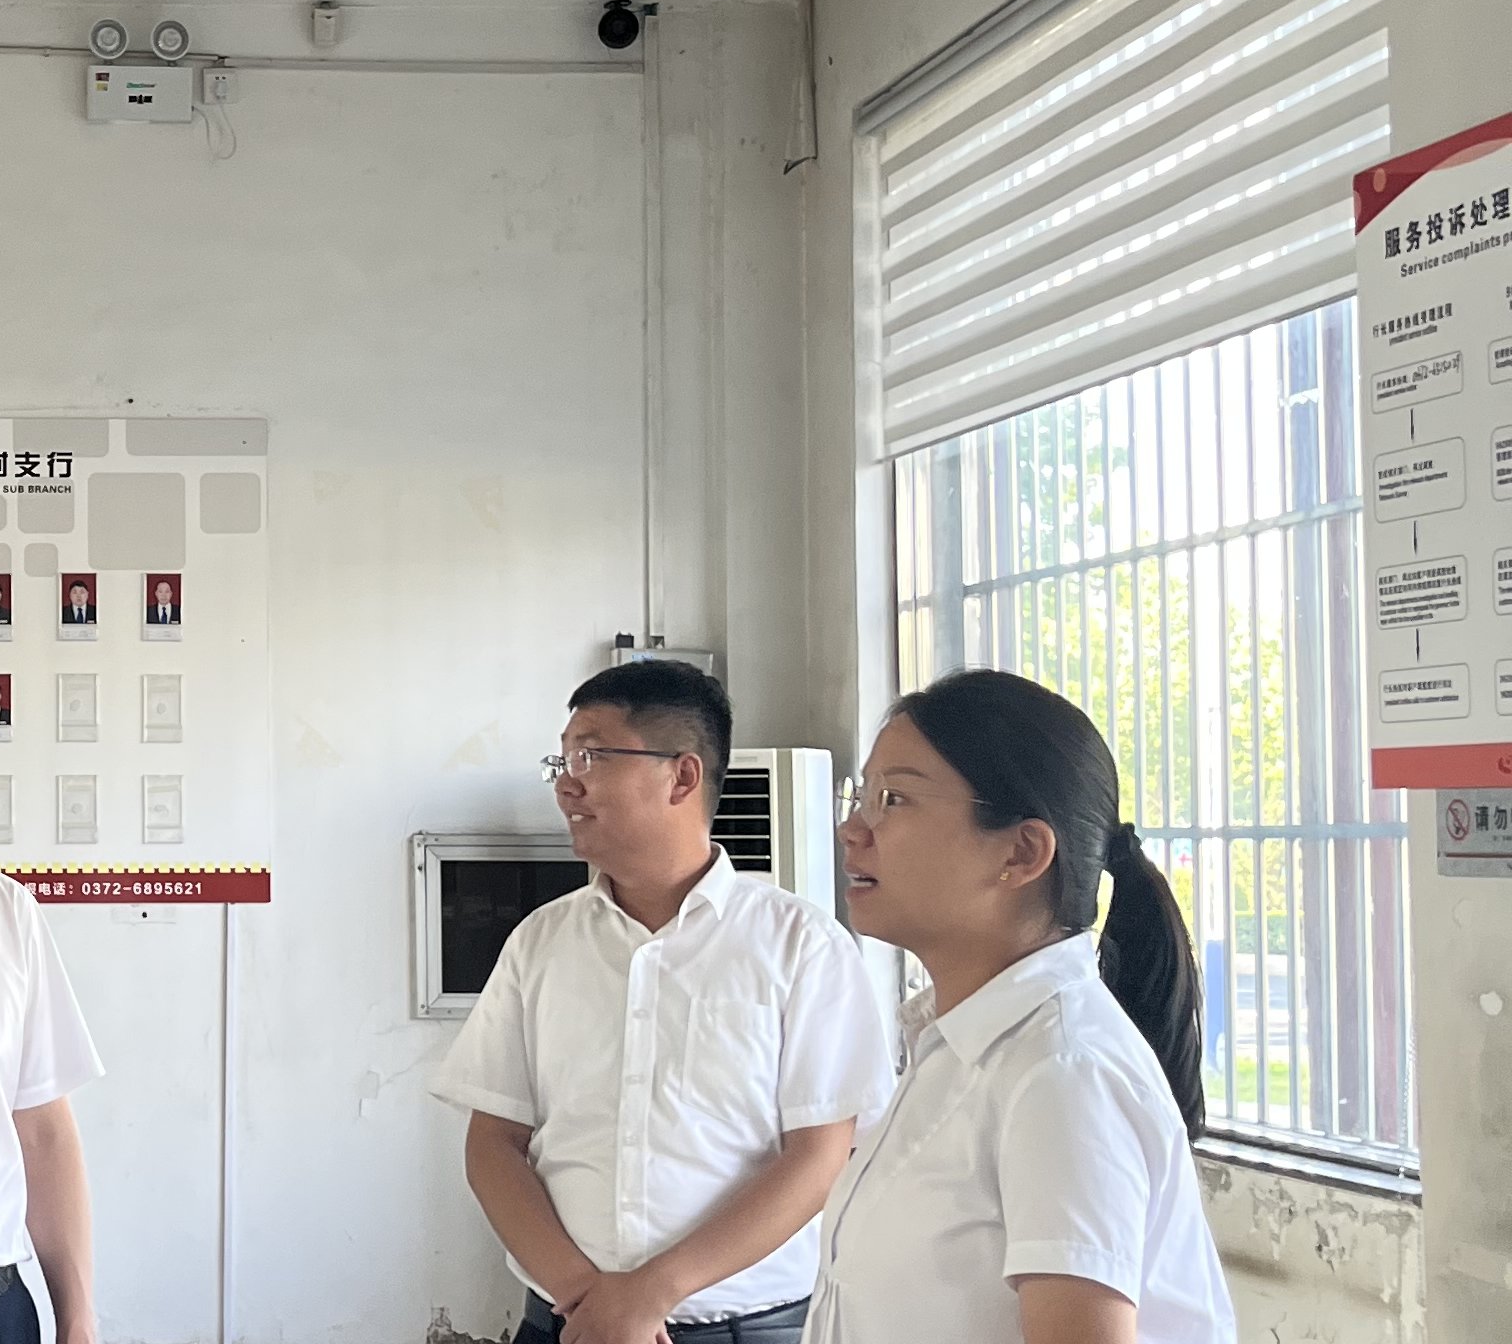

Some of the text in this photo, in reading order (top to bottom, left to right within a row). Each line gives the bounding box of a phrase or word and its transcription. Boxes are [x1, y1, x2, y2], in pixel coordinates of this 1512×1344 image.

[1384, 187, 1511, 259] 服务投诉处理
[1400, 256, 1439, 278] Service
[1441, 233, 1501, 260] complaints
[2, 484, 27, 494] SUB
[28, 484, 72, 494] BRANCH
[1475, 804, 1512, 831] 请勿
